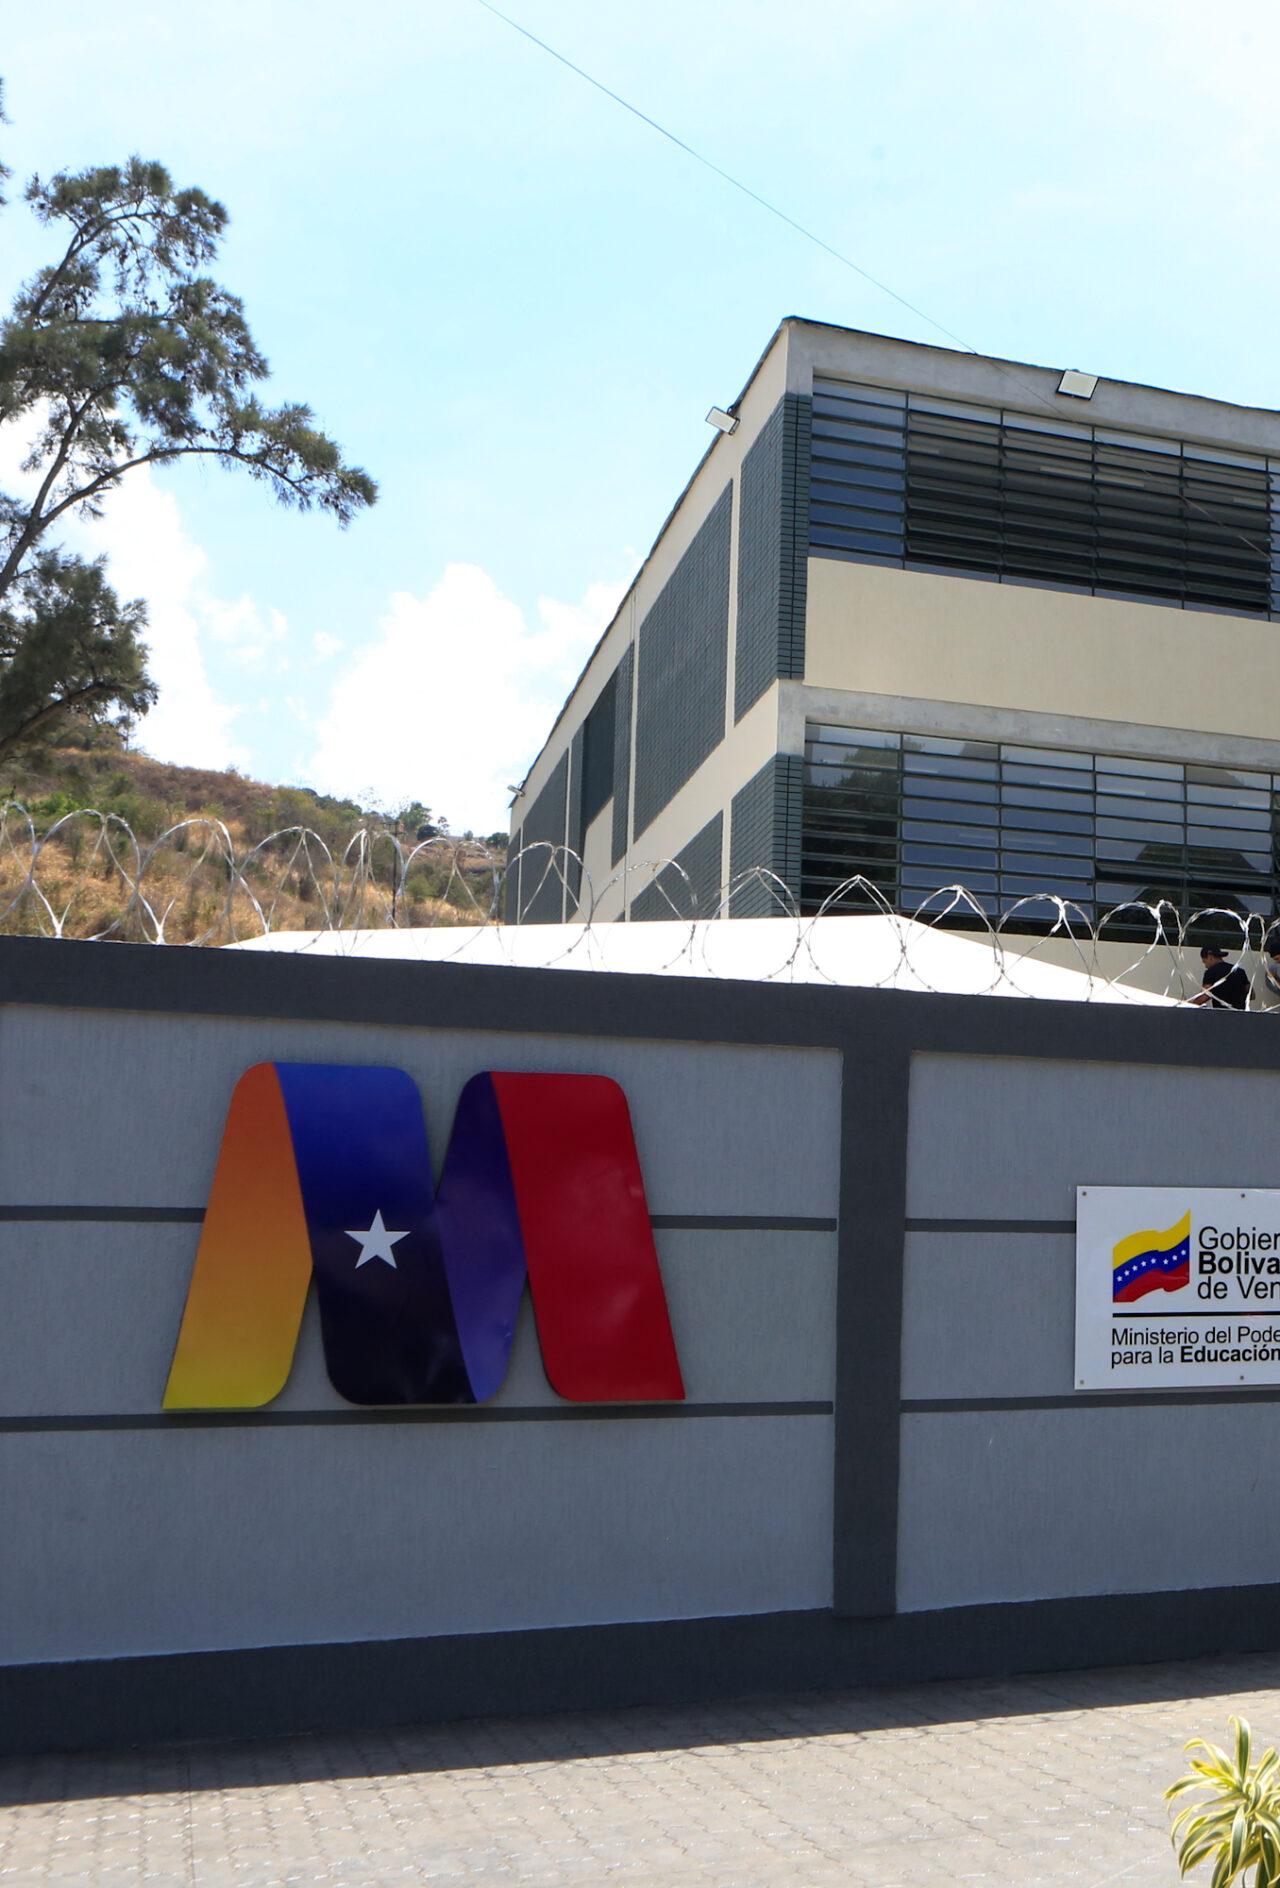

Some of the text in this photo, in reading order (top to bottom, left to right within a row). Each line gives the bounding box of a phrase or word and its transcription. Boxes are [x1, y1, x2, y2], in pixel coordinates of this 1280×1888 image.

[1197, 1276, 1228, 1299] de
[1111, 1327, 1199, 1346] Ministerio
[1205, 1326, 1231, 1343] del
[1111, 1350, 1152, 1369] para
[1159, 1347, 1174, 1364] la
